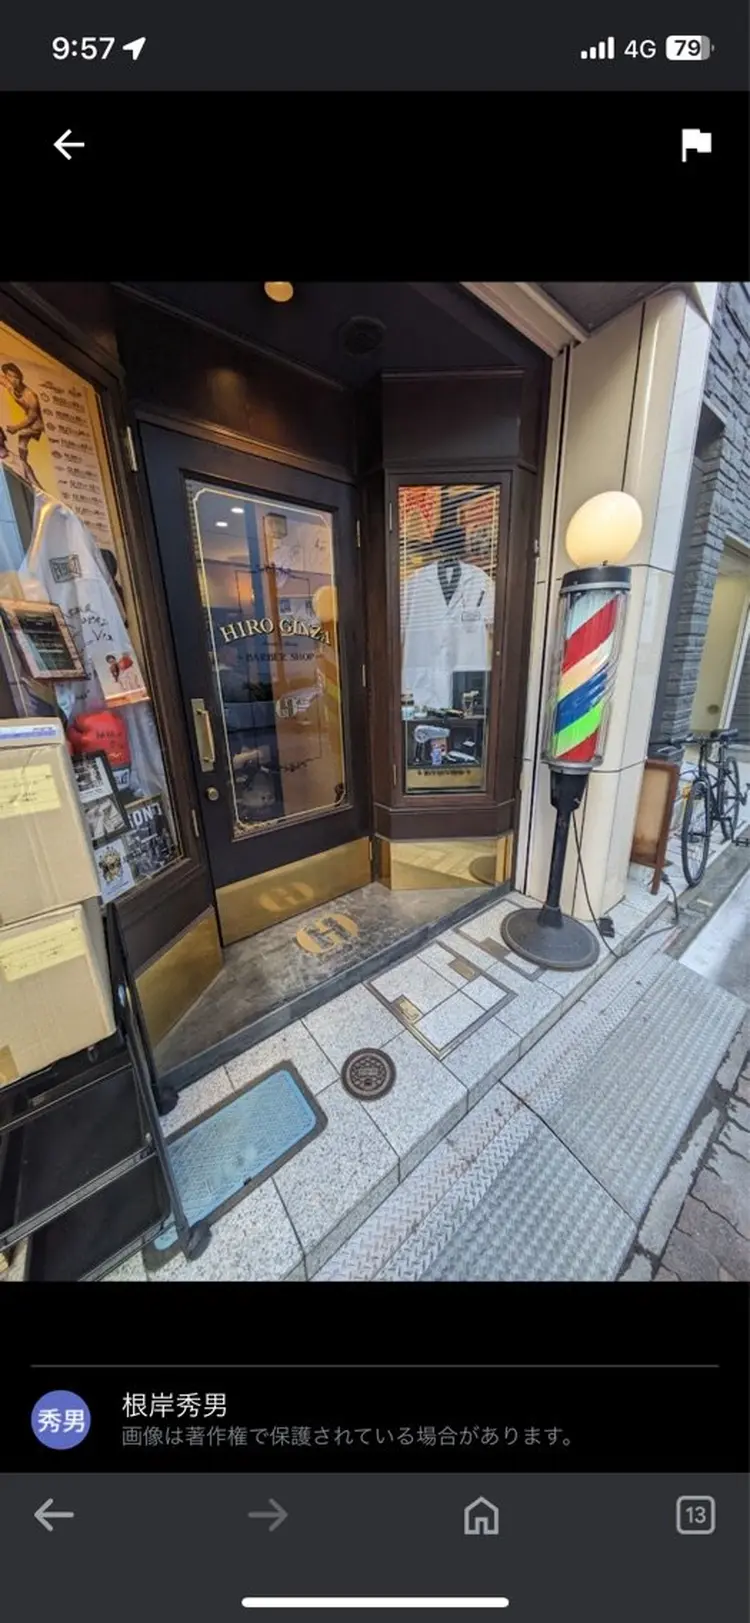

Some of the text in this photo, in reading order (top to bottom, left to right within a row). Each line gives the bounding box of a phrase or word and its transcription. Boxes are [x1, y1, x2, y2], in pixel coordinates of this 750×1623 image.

[219, 617, 332, 646] HIRO GINZA
[290, 652, 315, 662] SHOP
